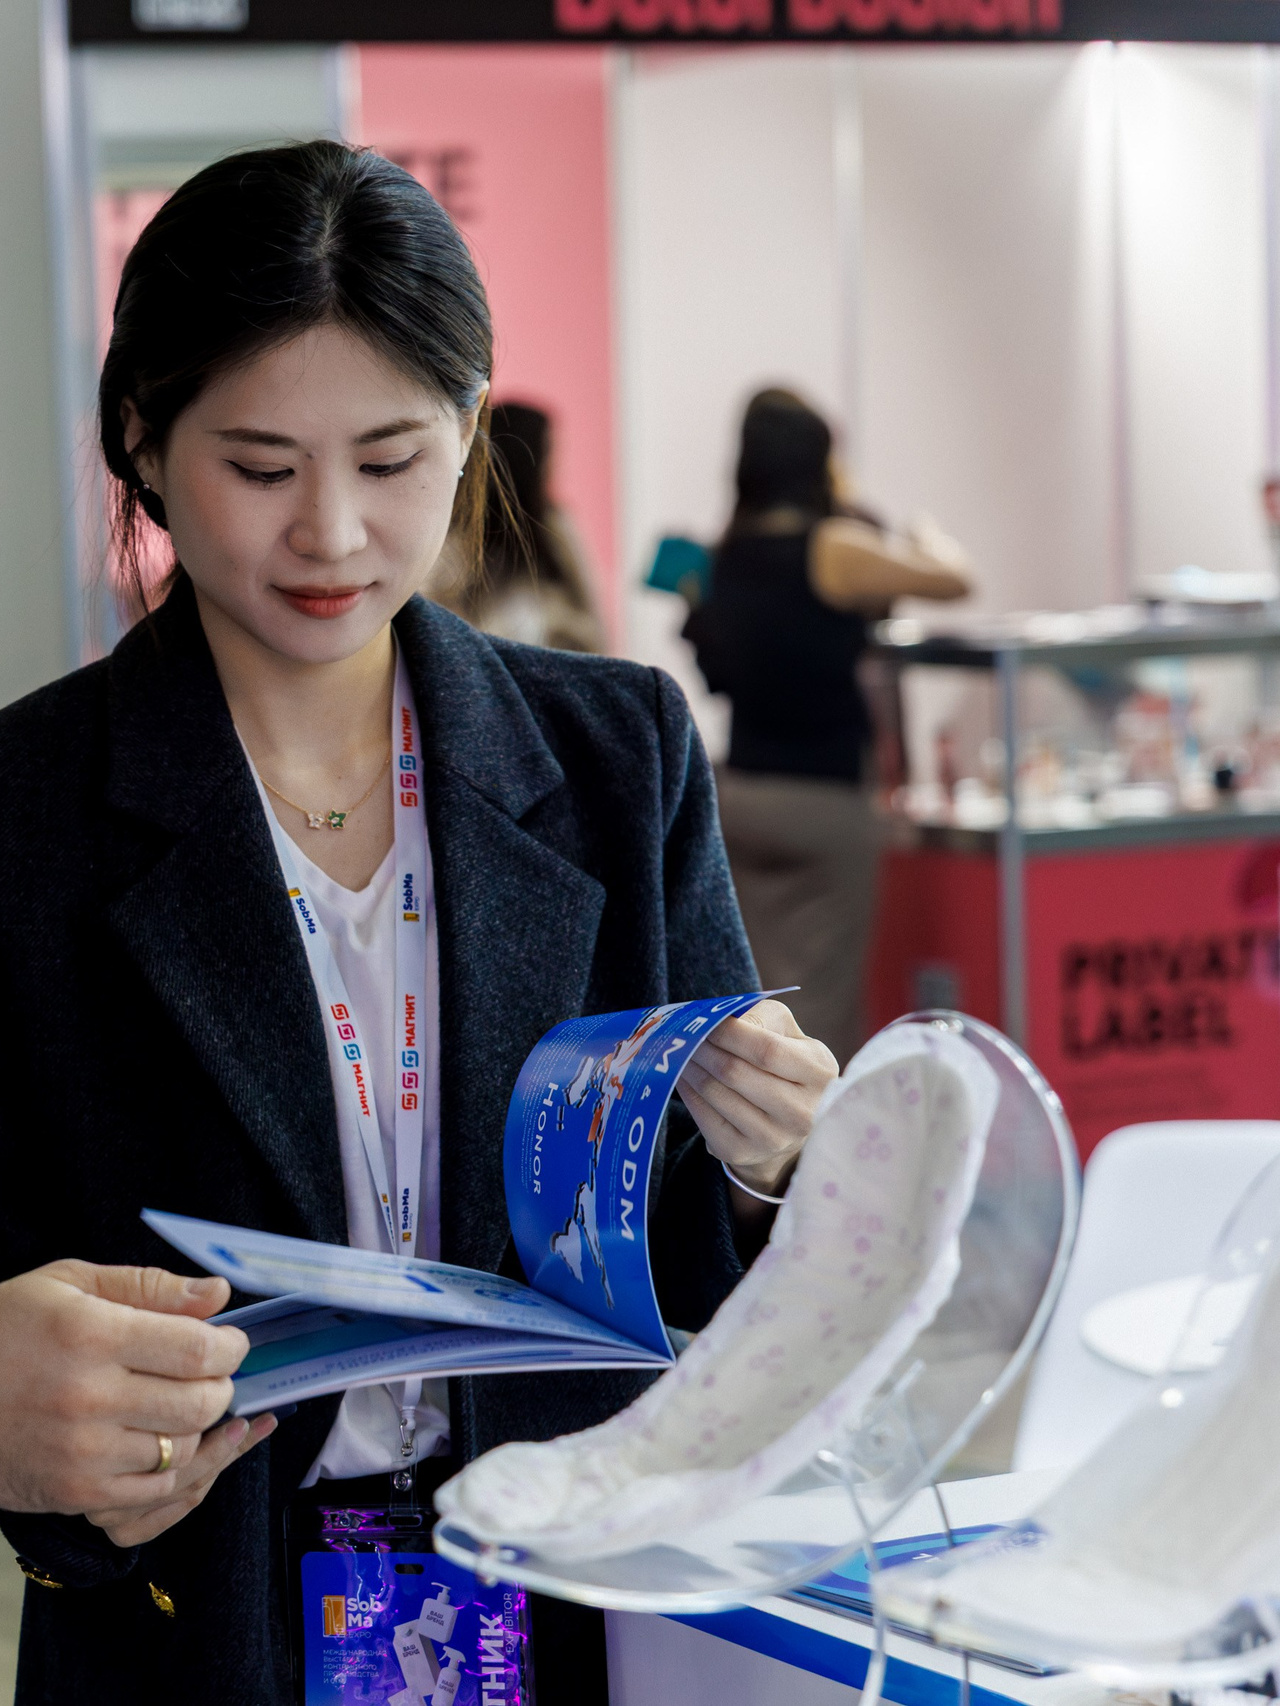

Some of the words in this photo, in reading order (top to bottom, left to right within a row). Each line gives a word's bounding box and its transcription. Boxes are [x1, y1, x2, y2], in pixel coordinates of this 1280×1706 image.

[402, 706, 413, 752] МАГНИТ
[296, 898, 316, 934] SobMa
[403, 873, 413, 910] SobMa
[405, 994, 415, 1047] МАГНИТ
[655, 996, 744, 1074] OEM
[1062, 995, 1233, 1061] LABEL
[352, 1064, 370, 1117] МАГНИТ
[640, 1085, 651, 1100] &
[533, 1082, 559, 1194] HONOR
[620, 1116, 645, 1241] ODM
[347, 1597, 382, 1612] Sob
[348, 1613, 373, 1628] Ma
[503, 1593, 515, 1653] EXHIBITOR
[349, 1631, 372, 1639] EXPO
